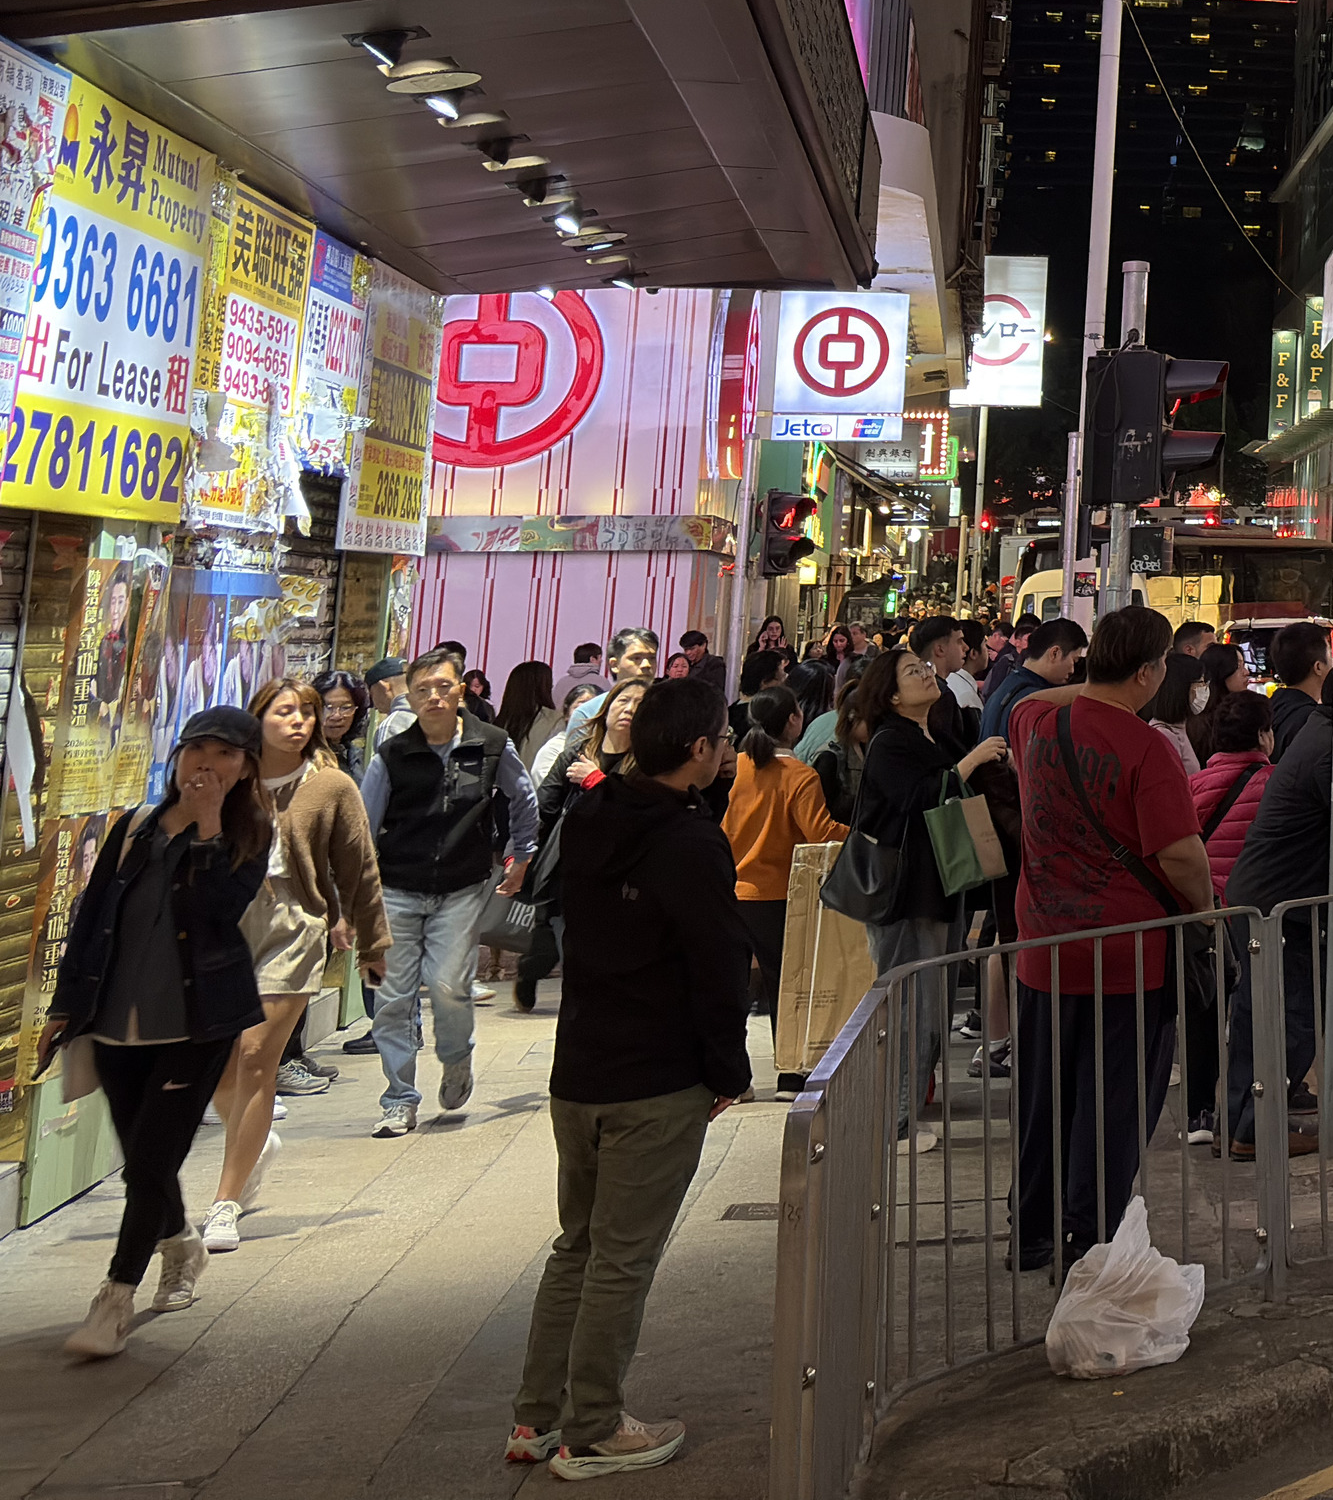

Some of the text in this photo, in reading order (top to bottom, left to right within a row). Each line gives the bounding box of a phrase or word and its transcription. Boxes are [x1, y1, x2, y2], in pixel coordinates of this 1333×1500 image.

[84, 104, 150, 211] 永昇
[153, 134, 201, 192] Mutual
[148, 177, 206, 245] Property
[127, 243, 199, 348] 6681
[20, 314, 191, 415] 出 For Lease 租
[224, 365, 290, 411] 9493-83
[227, 332, 292, 380] 9094-6651
[4, 404, 183, 504] 27811682
